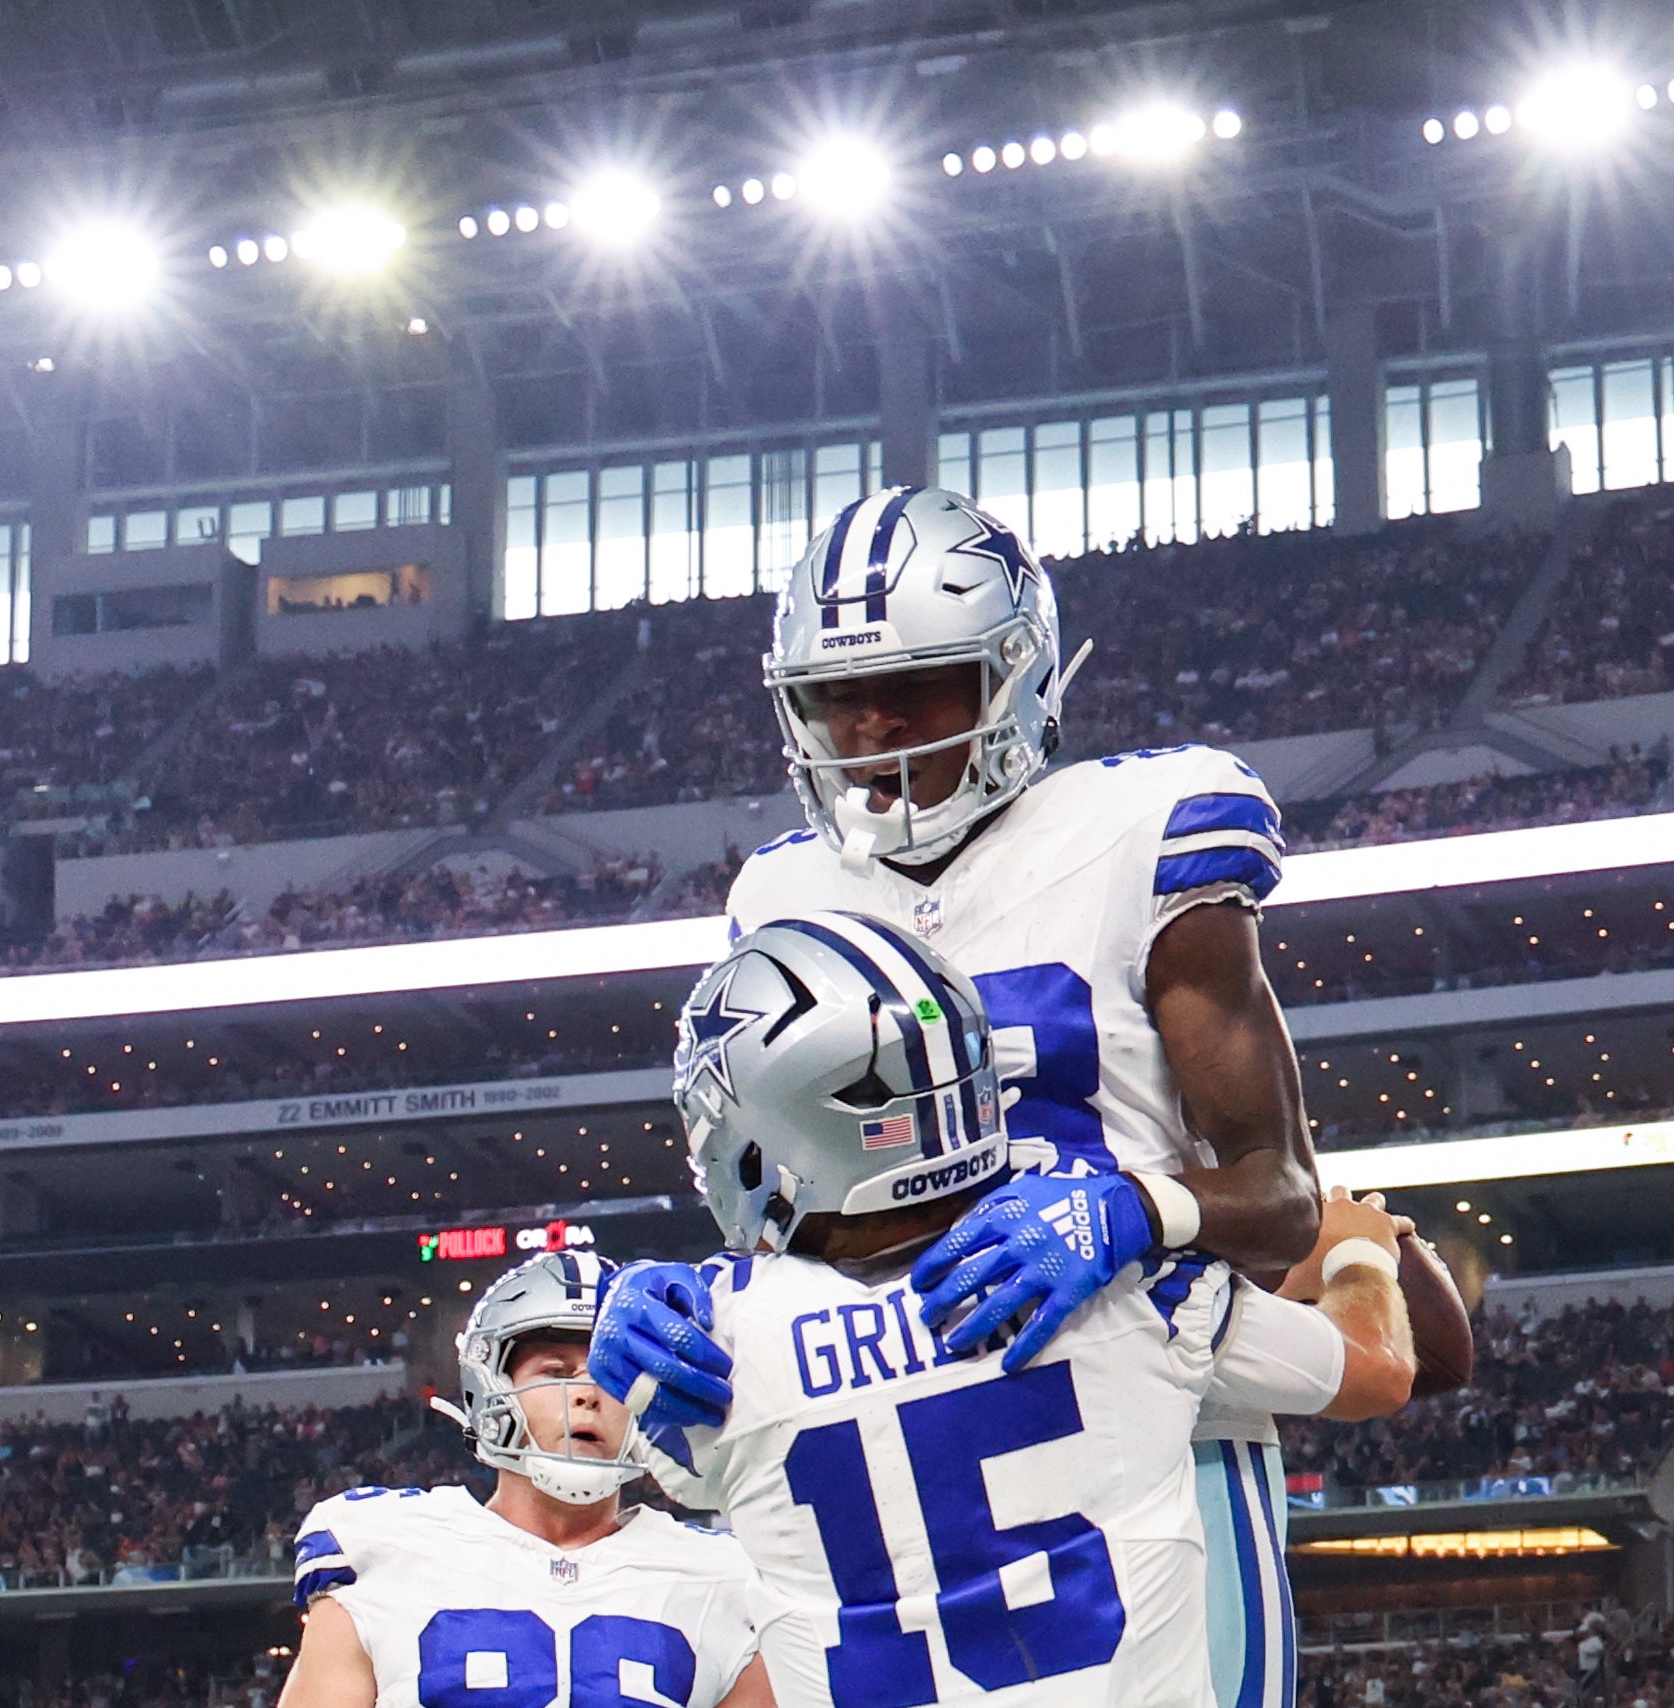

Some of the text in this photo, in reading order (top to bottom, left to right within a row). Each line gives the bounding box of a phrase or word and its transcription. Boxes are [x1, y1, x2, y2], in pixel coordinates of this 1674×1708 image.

[822, 631, 882, 649] COWBOYS
[309, 1096, 397, 1120] EMMITT
[405, 1091, 476, 1113] SMITH
[892, 1148, 998, 1200] COWBOYS
[1071, 1189, 1095, 1260] adidas
[438, 1227, 507, 1259] POLLOCK
